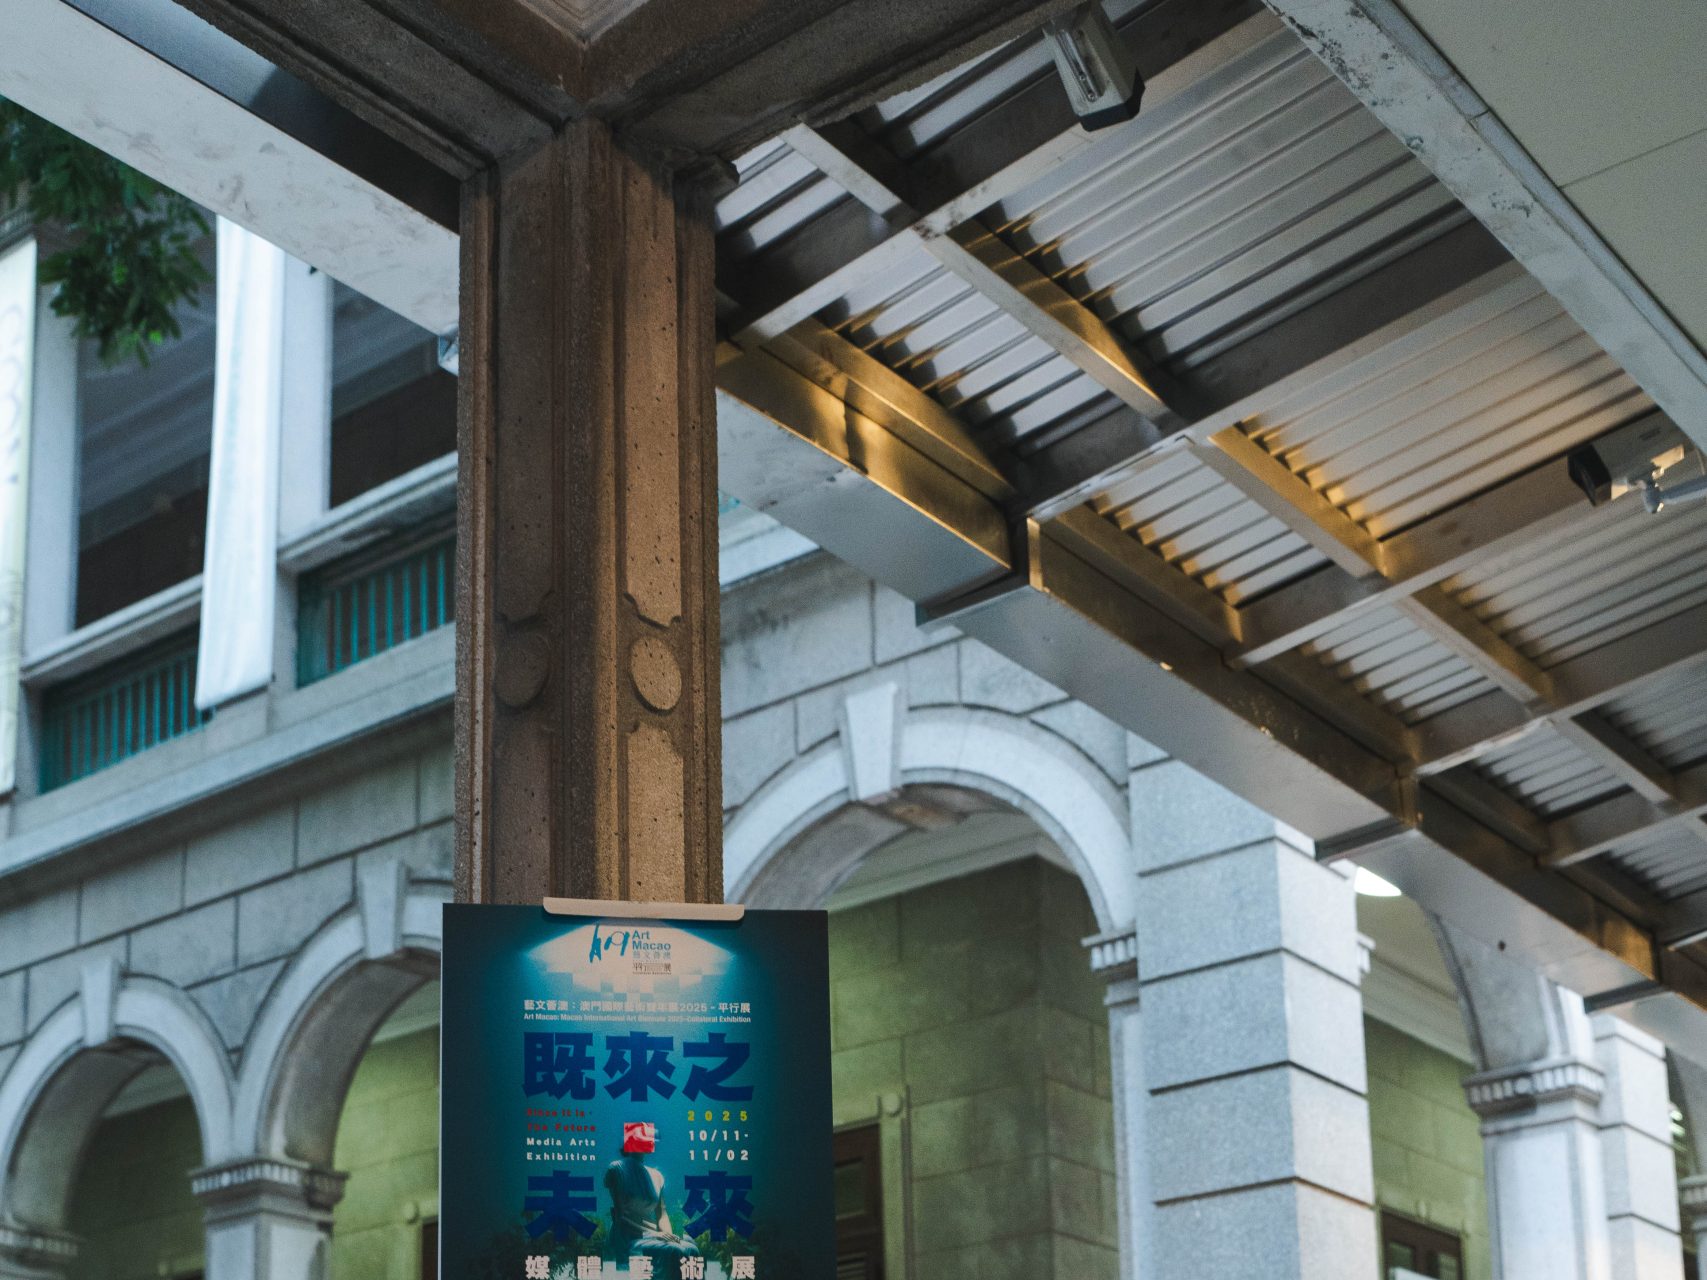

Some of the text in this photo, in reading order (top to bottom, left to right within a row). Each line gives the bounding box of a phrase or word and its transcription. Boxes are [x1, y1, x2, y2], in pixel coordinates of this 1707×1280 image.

[631, 930, 650, 940] Art
[632, 941, 671, 951] Macao
[719, 1015, 751, 1023] Exhibition
[522, 1031, 754, 1102] 既來之
[687, 1110, 748, 1121] 2025
[555, 1123, 596, 1132] Future
[526, 1137, 596, 1147] Media Arts
[526, 1152, 596, 1161] Exhibition
[689, 1149, 749, 1162] 11/02
[525, 1255, 756, 1280] 媒體藝術展
